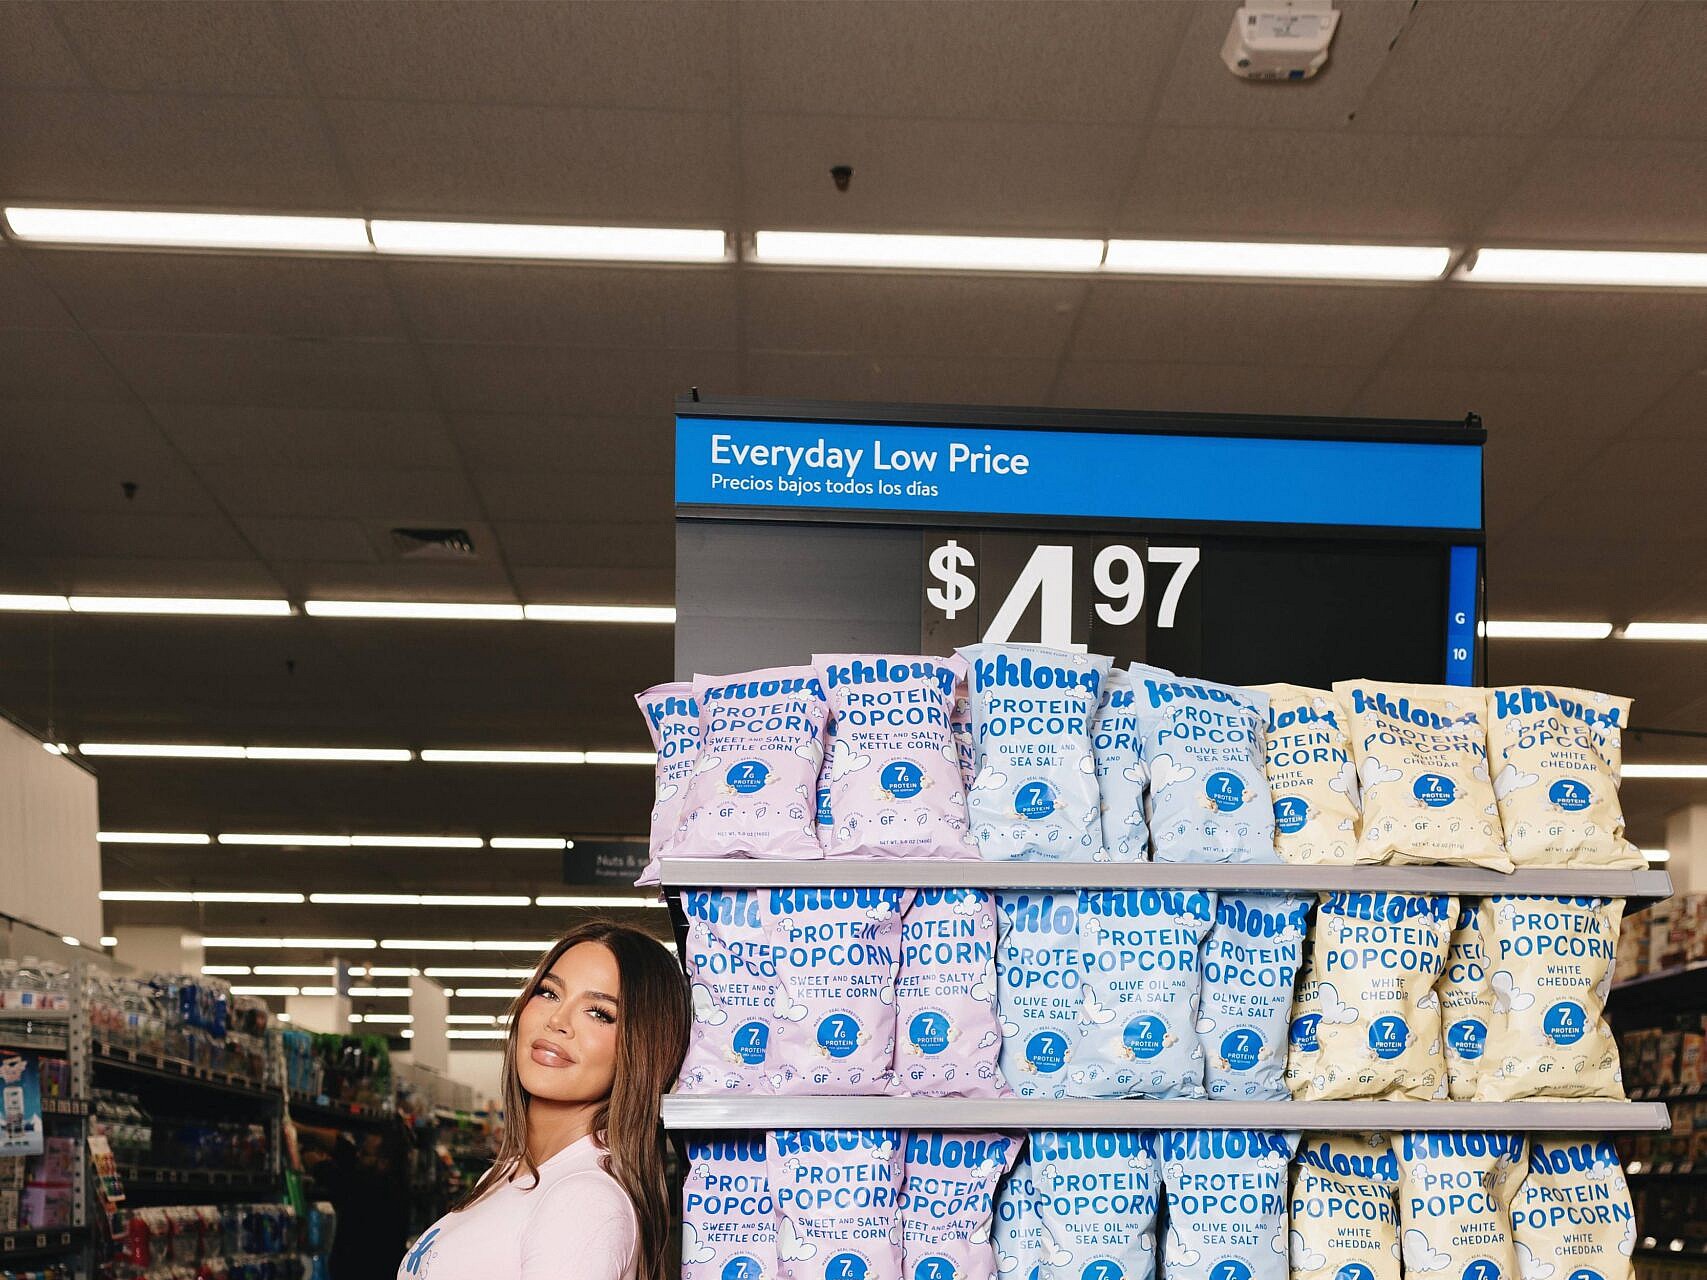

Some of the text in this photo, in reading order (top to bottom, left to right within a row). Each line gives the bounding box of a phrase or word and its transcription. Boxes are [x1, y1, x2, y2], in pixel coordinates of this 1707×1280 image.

[711, 434, 1029, 477] Everyday Low Price
[711, 474, 938, 499] Precios bajos todos los días
[1455, 612, 1465, 624] G
[1453, 648, 1467, 660] 10
[848, 689, 942, 707] PROTEIN
[989, 699, 1086, 714] PROTEIN
[852, 733, 888, 741] SWEET
[912, 732, 944, 741] SALTY
[860, 741, 939, 750] KETTLE CORN
[1000, 745, 1034, 754] OLIVE
[1039, 744, 1057, 753] OIL
[1010, 757, 1064, 766] SEA SALT
[1550, 752, 1586, 761] WHITE
[1541, 761, 1598, 772] CHEDDAR
[881, 816, 894, 825] GF
[1549, 827, 1563, 836] GF
[1512, 913, 1600, 934] PROTEIN
[790, 922, 880, 942] PROTEIN
[1098, 929, 1199, 946] PROTEIN
[1500, 936, 1614, 960] POPCORN
[773, 944, 892, 967] POPCORN
[1547, 966, 1581, 974] WHITE
[790, 976, 829, 986] SWEET
[851, 975, 883, 985] SALTY
[1110, 981, 1144, 991] OLIVE
[1149, 980, 1169, 990] OIL
[1537, 977, 1591, 987] CHEDDAR
[797, 988, 877, 998] KETTLE CORN
[1119, 993, 1175, 1003] SEA SALT
[1538, 1064, 1553, 1072] GF
[814, 1074, 828, 1083] GF
[1118, 1074, 1131, 1083] GF
[796, 1164, 891, 1184] PROTEIN
[1053, 1173, 1148, 1192] PROTEIN
[1526, 1183, 1609, 1204] PROTEIN
[1041, 1193, 1158, 1216] POPCORN
[1513, 1202, 1631, 1230] POPCORN
[799, 1218, 835, 1227] SWEET
[857, 1217, 889, 1227] SALTY
[1065, 1223, 1099, 1232] OLIVE
[1104, 1223, 1123, 1232] OIL
[807, 1229, 887, 1239] KETTLE CORN
[1338, 1228, 1371, 1238] WHITE
[1075, 1235, 1130, 1244] SEA SALT
[1563, 1234, 1593, 1244] WHITE
[1328, 1239, 1381, 1250] CHEDDAR
[1555, 1245, 1603, 1255] CHEDDAR
